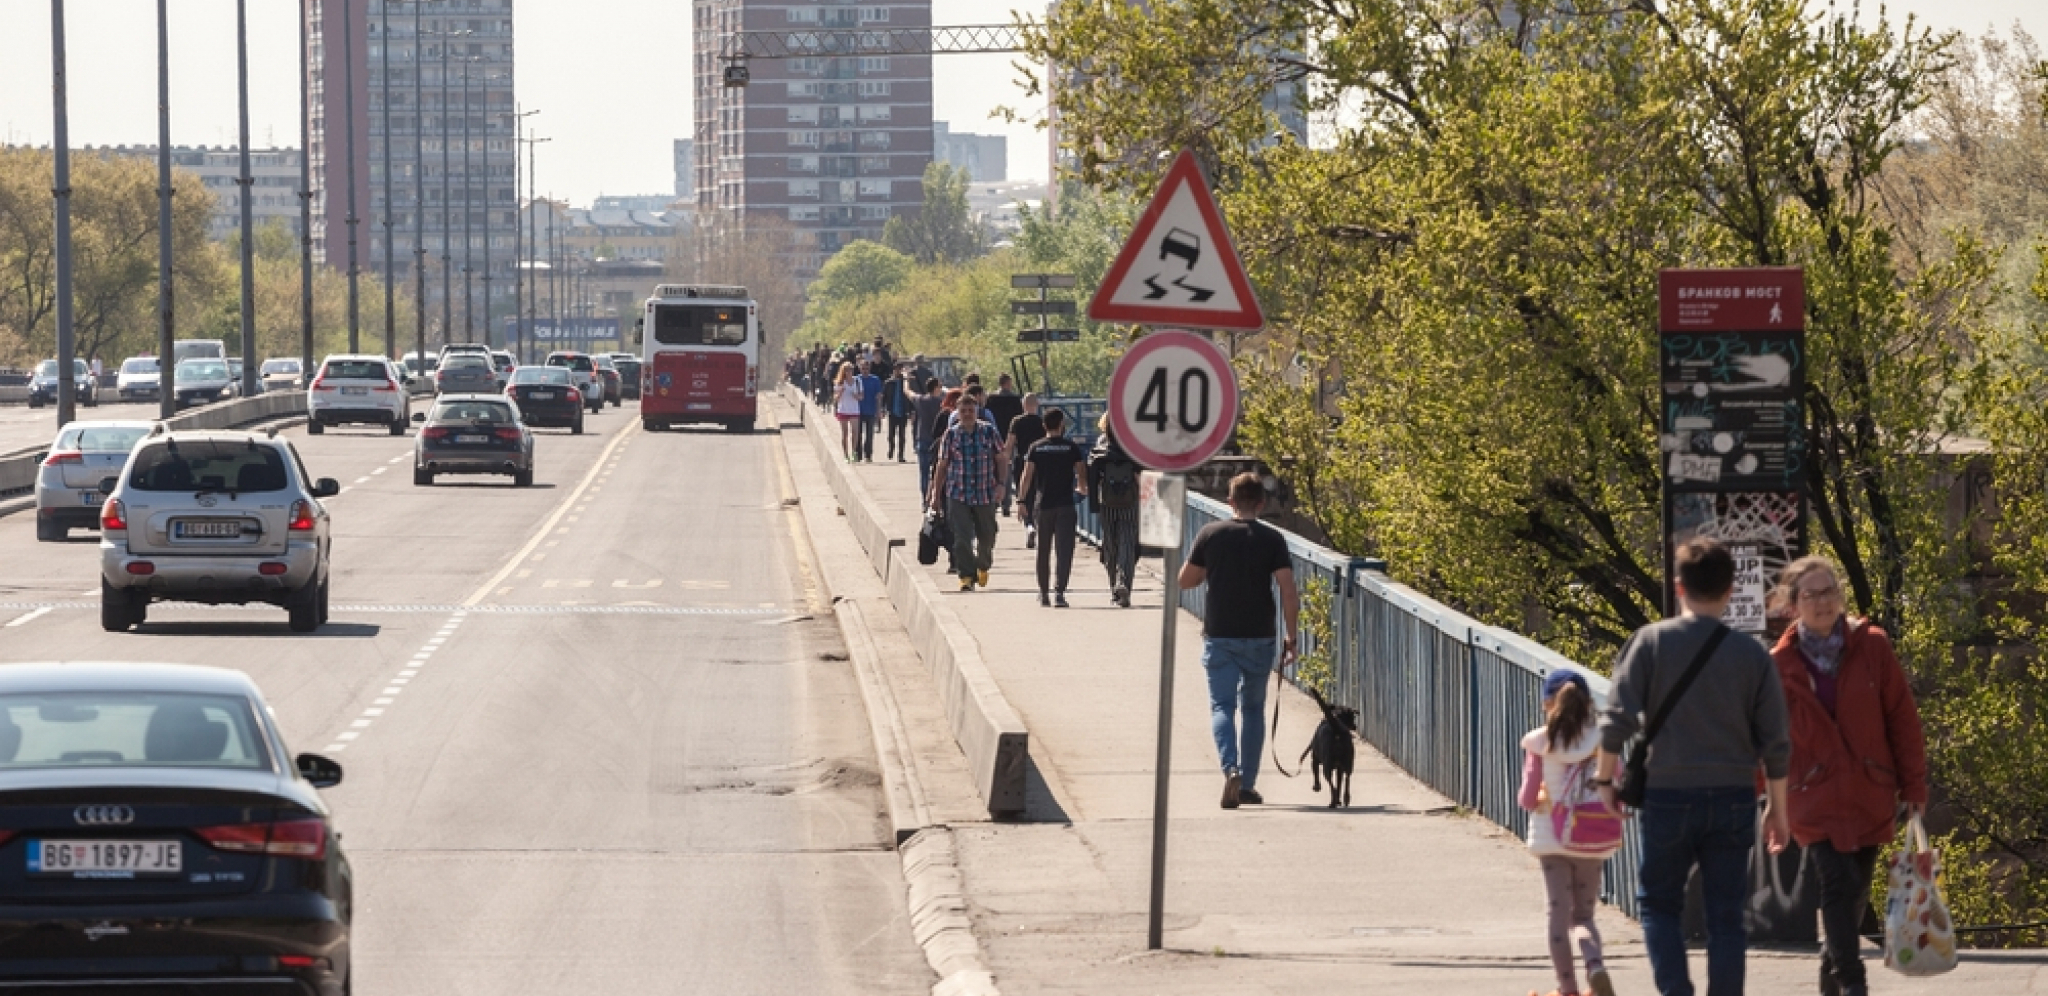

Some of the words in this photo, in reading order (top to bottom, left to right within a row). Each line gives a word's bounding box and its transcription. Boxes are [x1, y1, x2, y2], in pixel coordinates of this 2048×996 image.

[1678, 286, 1741, 298] БРАНКОВ
[1745, 286, 1782, 298] МОСТ
[1134, 366, 1210, 433] 40
[45, 844, 71, 867] BG
[91, 844, 178, 867] 1897-JE
